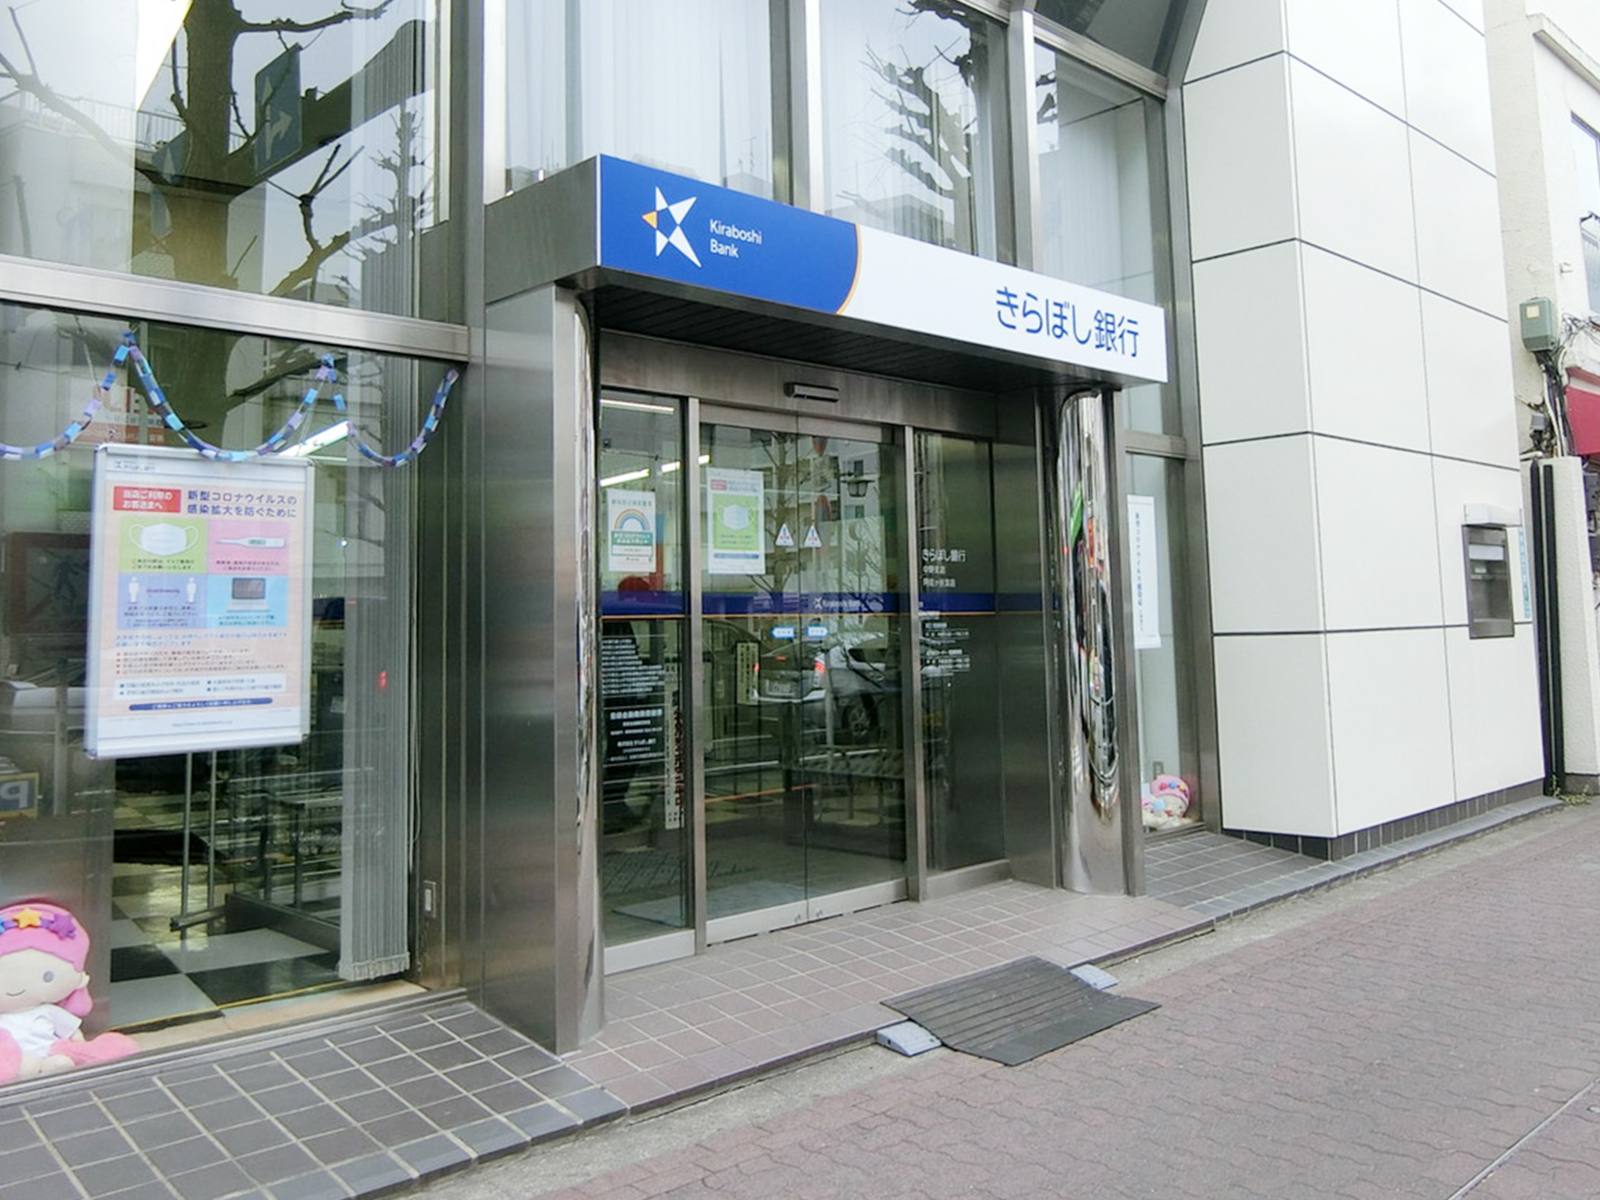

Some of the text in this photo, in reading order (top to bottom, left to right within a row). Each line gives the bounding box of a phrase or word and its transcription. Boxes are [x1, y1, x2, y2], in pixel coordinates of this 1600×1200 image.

[710, 218, 762, 245] Kiraboshi
[710, 238, 739, 259] Bank
[996, 286, 1139, 357] きらぼし銀行
[187, 489, 298, 506] 新型コロナウイルスの
[187, 503, 297, 518] 感染拡大を防ぐために
